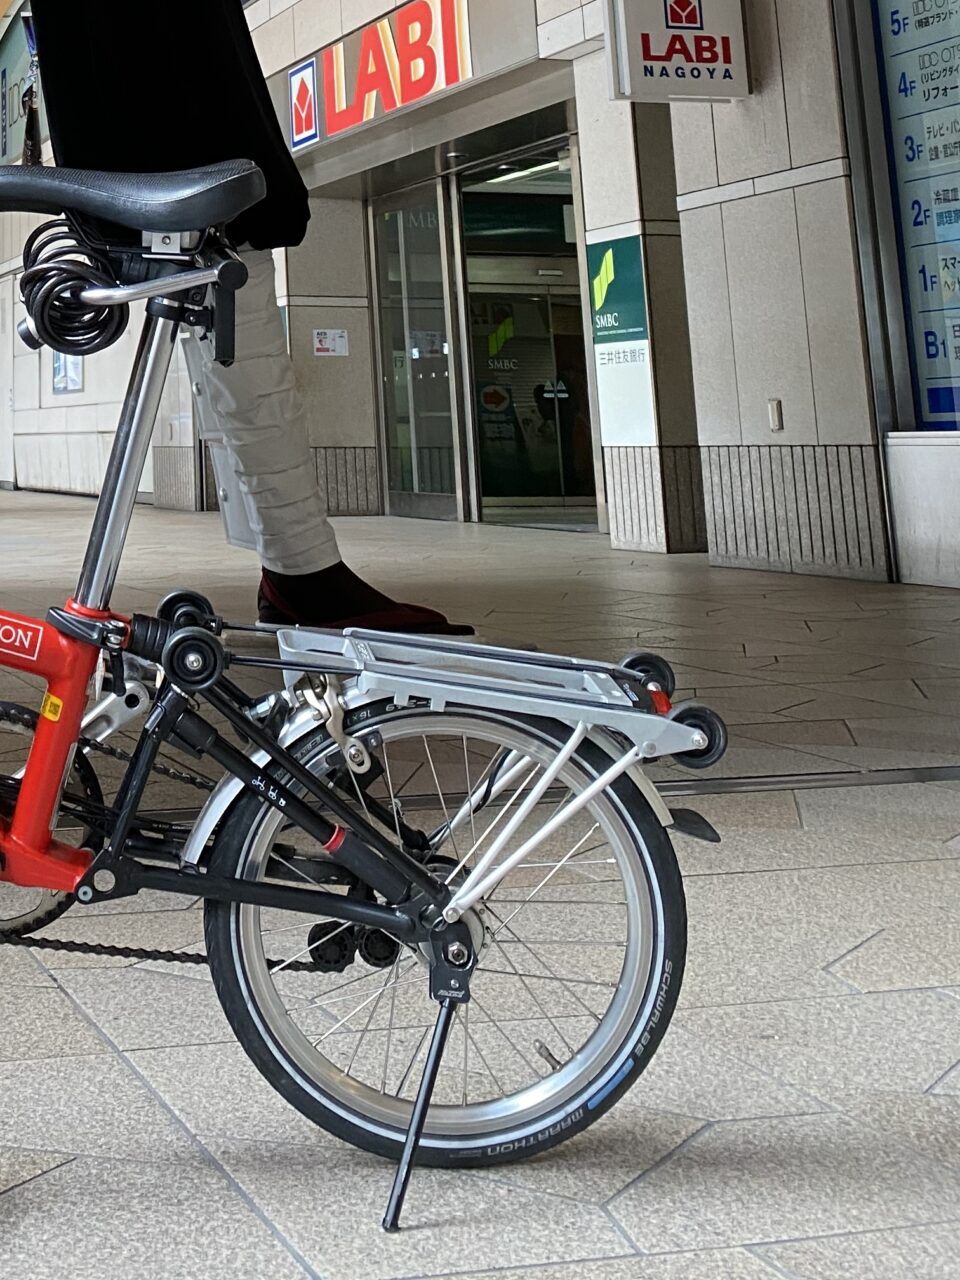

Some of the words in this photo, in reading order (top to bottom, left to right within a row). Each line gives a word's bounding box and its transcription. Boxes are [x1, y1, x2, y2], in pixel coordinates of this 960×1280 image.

[890, 9, 909, 37] 5F
[641, 32, 732, 65] LABI
[644, 64, 733, 80] NAGOYA
[898, 71, 916, 98] 4F
[904, 135, 923, 162] 3F
[911, 199, 930, 227] 2F
[918, 264, 937, 292] 1F
[595, 312, 619, 329] SMBC
[599, 349, 646, 366] 三井住友銀行
[924, 330, 947, 359] B1
[488, 359, 518, 369] SMBC
[634, 959, 673, 1057] SCHWALBE
[487, 1110, 584, 1156] MARATHON
